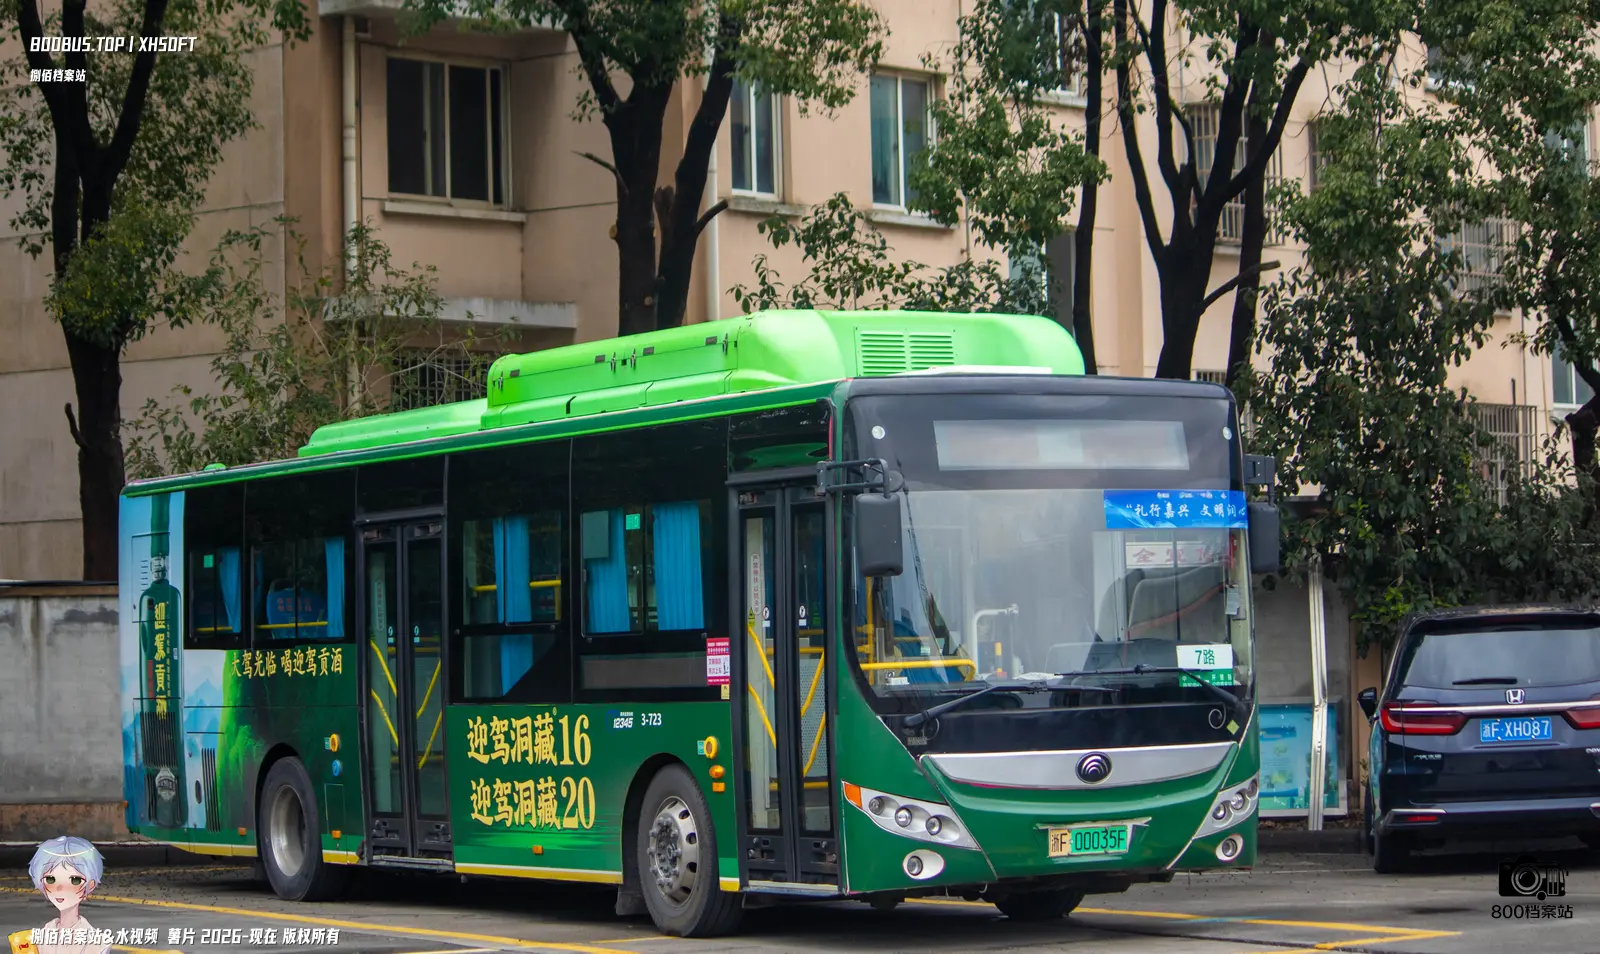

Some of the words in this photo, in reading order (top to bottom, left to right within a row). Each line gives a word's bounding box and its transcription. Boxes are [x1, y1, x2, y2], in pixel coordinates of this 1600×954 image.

[231, 649, 276, 679] 大驾光临
[280, 646, 343, 677] 喝迎驾贡酒
[1194, 649, 1215, 665] 7路
[613, 717, 633, 729] 12345
[641, 712, 662, 726] 3-723
[470, 775, 596, 830] 迎驾洞藏20
